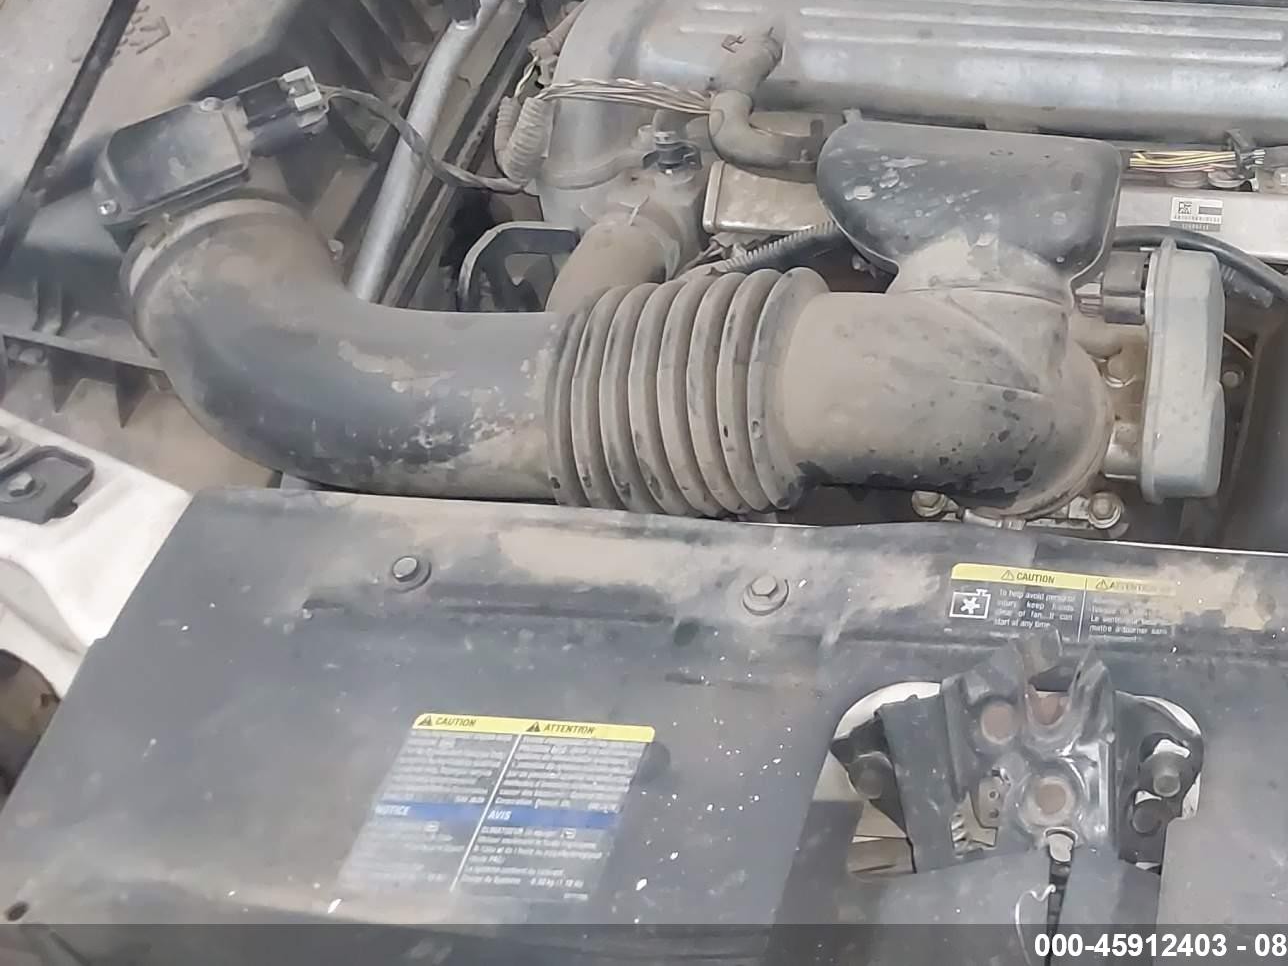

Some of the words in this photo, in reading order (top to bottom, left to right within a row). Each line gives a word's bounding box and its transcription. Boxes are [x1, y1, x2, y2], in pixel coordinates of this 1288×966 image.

[1016, 571, 1056, 585] CAUTION
[1026, 601, 1045, 610] keep
[1018, 610, 1026, 618] of
[435, 716, 478, 728] CAUTION
[542, 722, 596, 736] ATTENTION
[487, 809, 512, 821] AVIS
